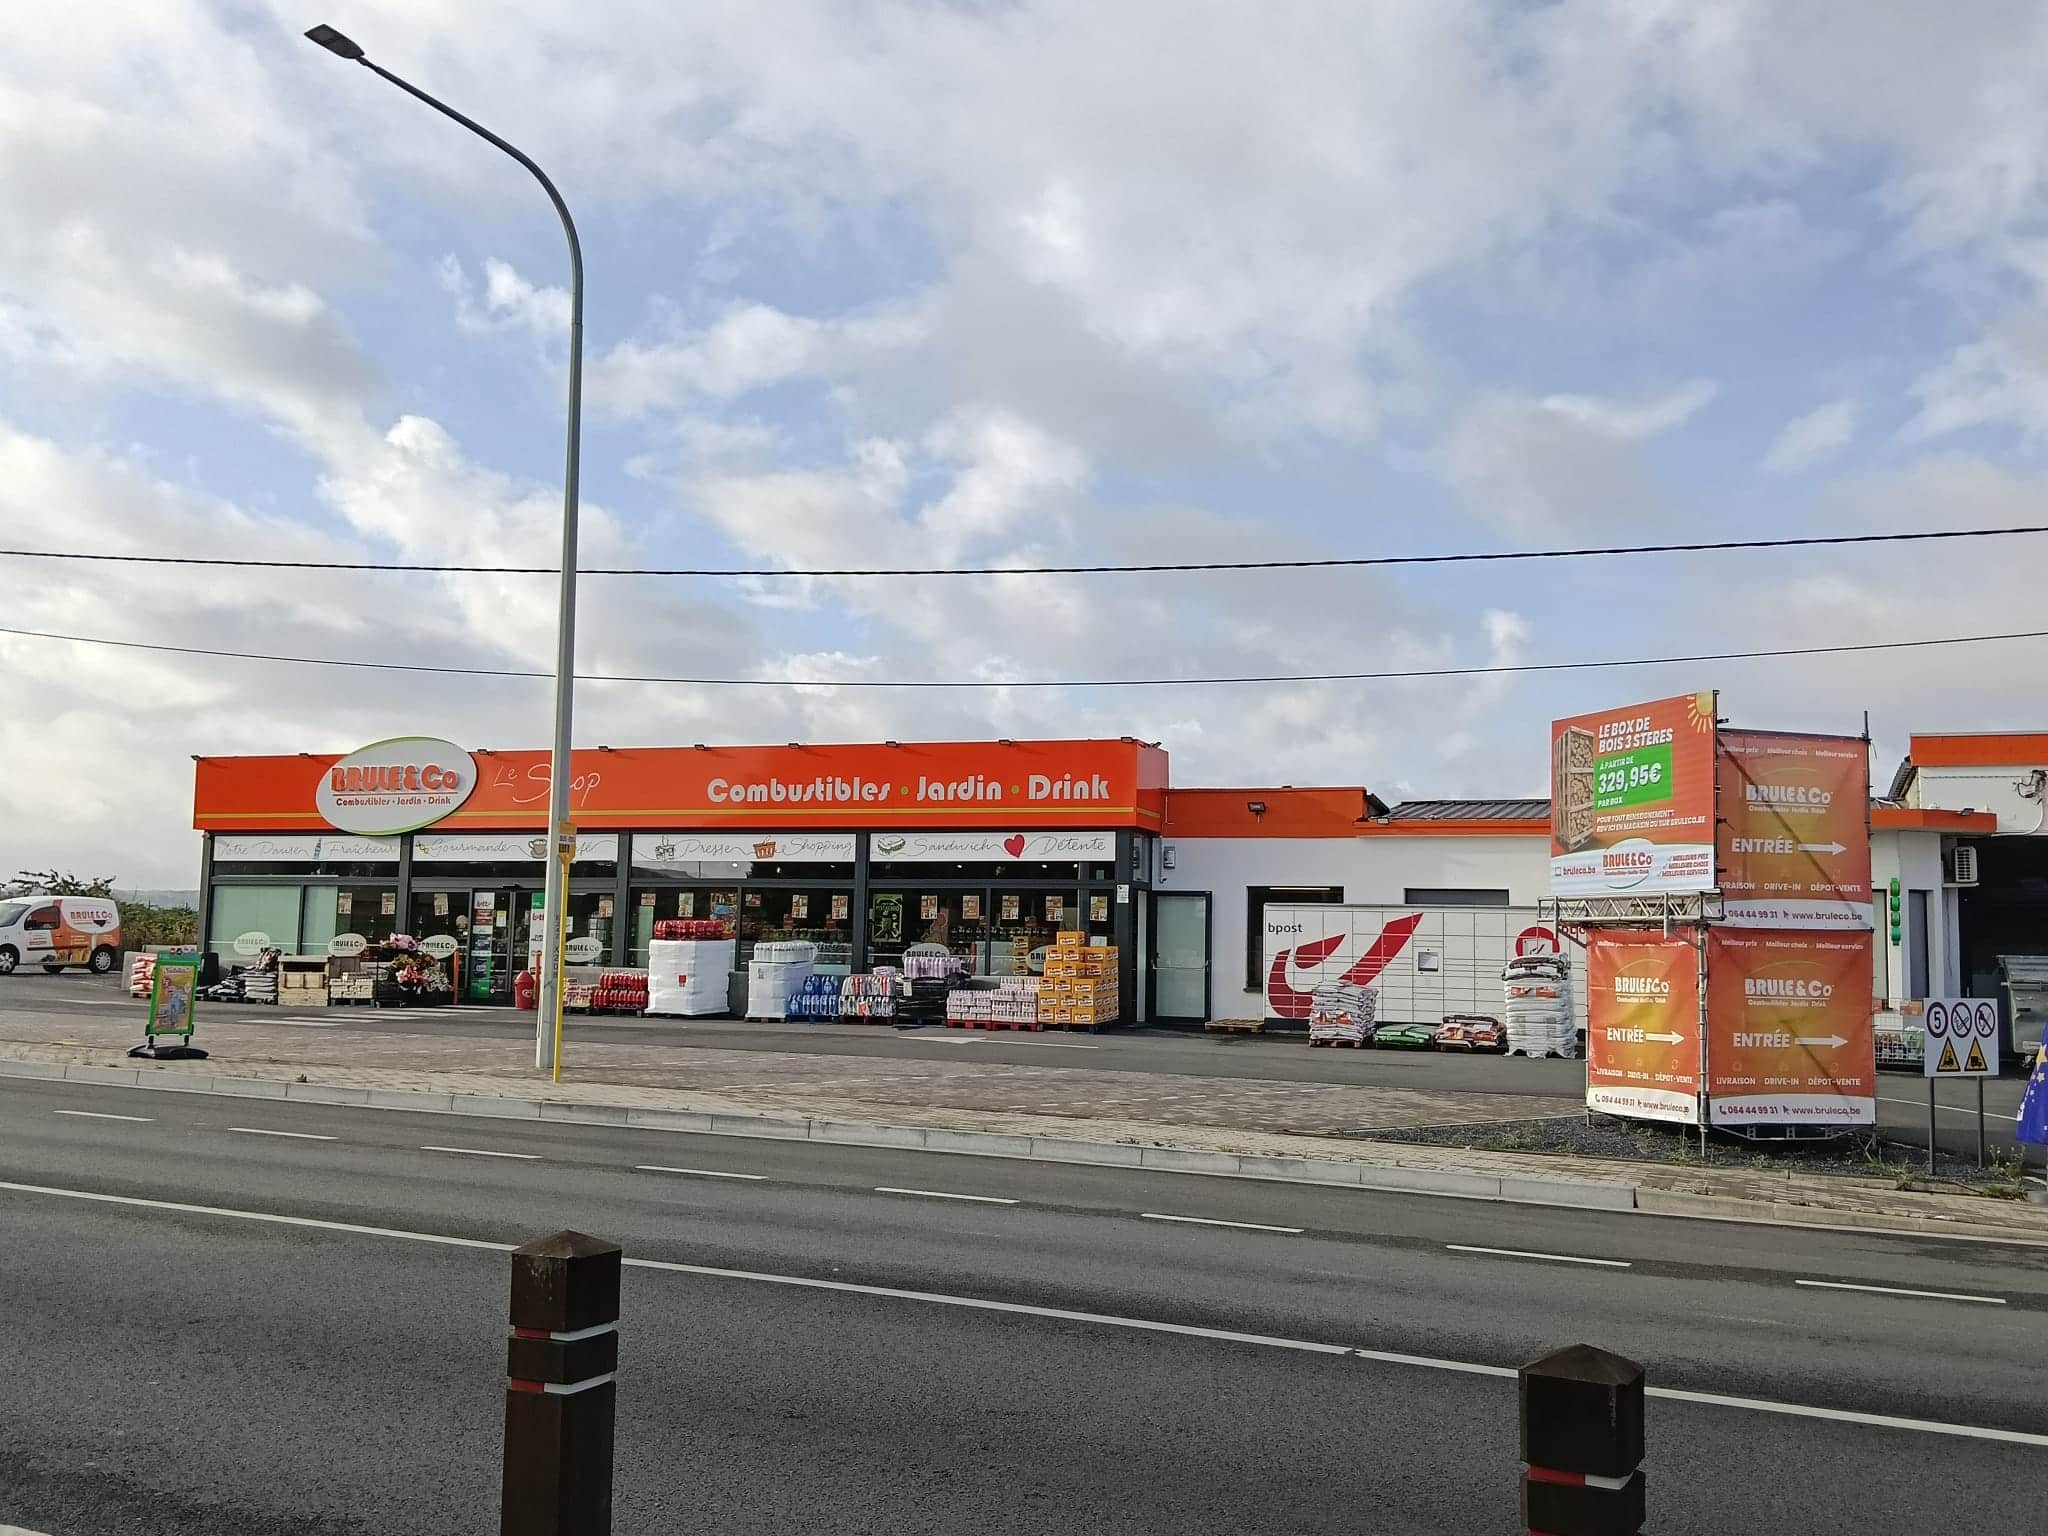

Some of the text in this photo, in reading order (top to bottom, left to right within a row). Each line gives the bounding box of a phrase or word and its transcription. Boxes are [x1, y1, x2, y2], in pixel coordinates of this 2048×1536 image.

[1599, 717, 1650, 738] LE BOX DE
[1599, 728, 1674, 753] BOIS 3 STERES
[331, 763, 459, 792] BRULE&Co
[493, 763, 601, 807] Le Sop
[1598, 763, 1662, 794] 329,95€
[707, 773, 1110, 803] Combustibles Jardin Drink
[1746, 783, 1832, 803] BRULE&Co
[336, 795, 451, 807] Combustibles Jardin Drink
[677, 839, 736, 858] Presse
[908, 836, 1106, 856] Sandwich Détente
[1731, 835, 1793, 853] ENTRÉE
[1603, 851, 1653, 868] BRULE&Co
[1764, 883, 1801, 891] DRIVE-IN
[1745, 910, 1757, 918] 44
[1792, 911, 1863, 921] www.bruleco.be
[1268, 922, 1303, 935] bpost
[1744, 978, 1833, 997] BRULE&Co
[1933, 1011, 1941, 1032] 5
[1607, 1024, 1645, 1043] ENTRÉE
[1733, 1029, 1791, 1048] ENTRÉE
[1716, 1077, 1756, 1085] LIVRAISON
[1764, 1077, 1800, 1086] DRIVE-IN
[1727, 1105, 1744, 1114] 064
[1745, 1105, 1757, 1114] 44
[1769, 1105, 1779, 1114] 31
[1791, 1105, 1861, 1116] www.bruleco.be
